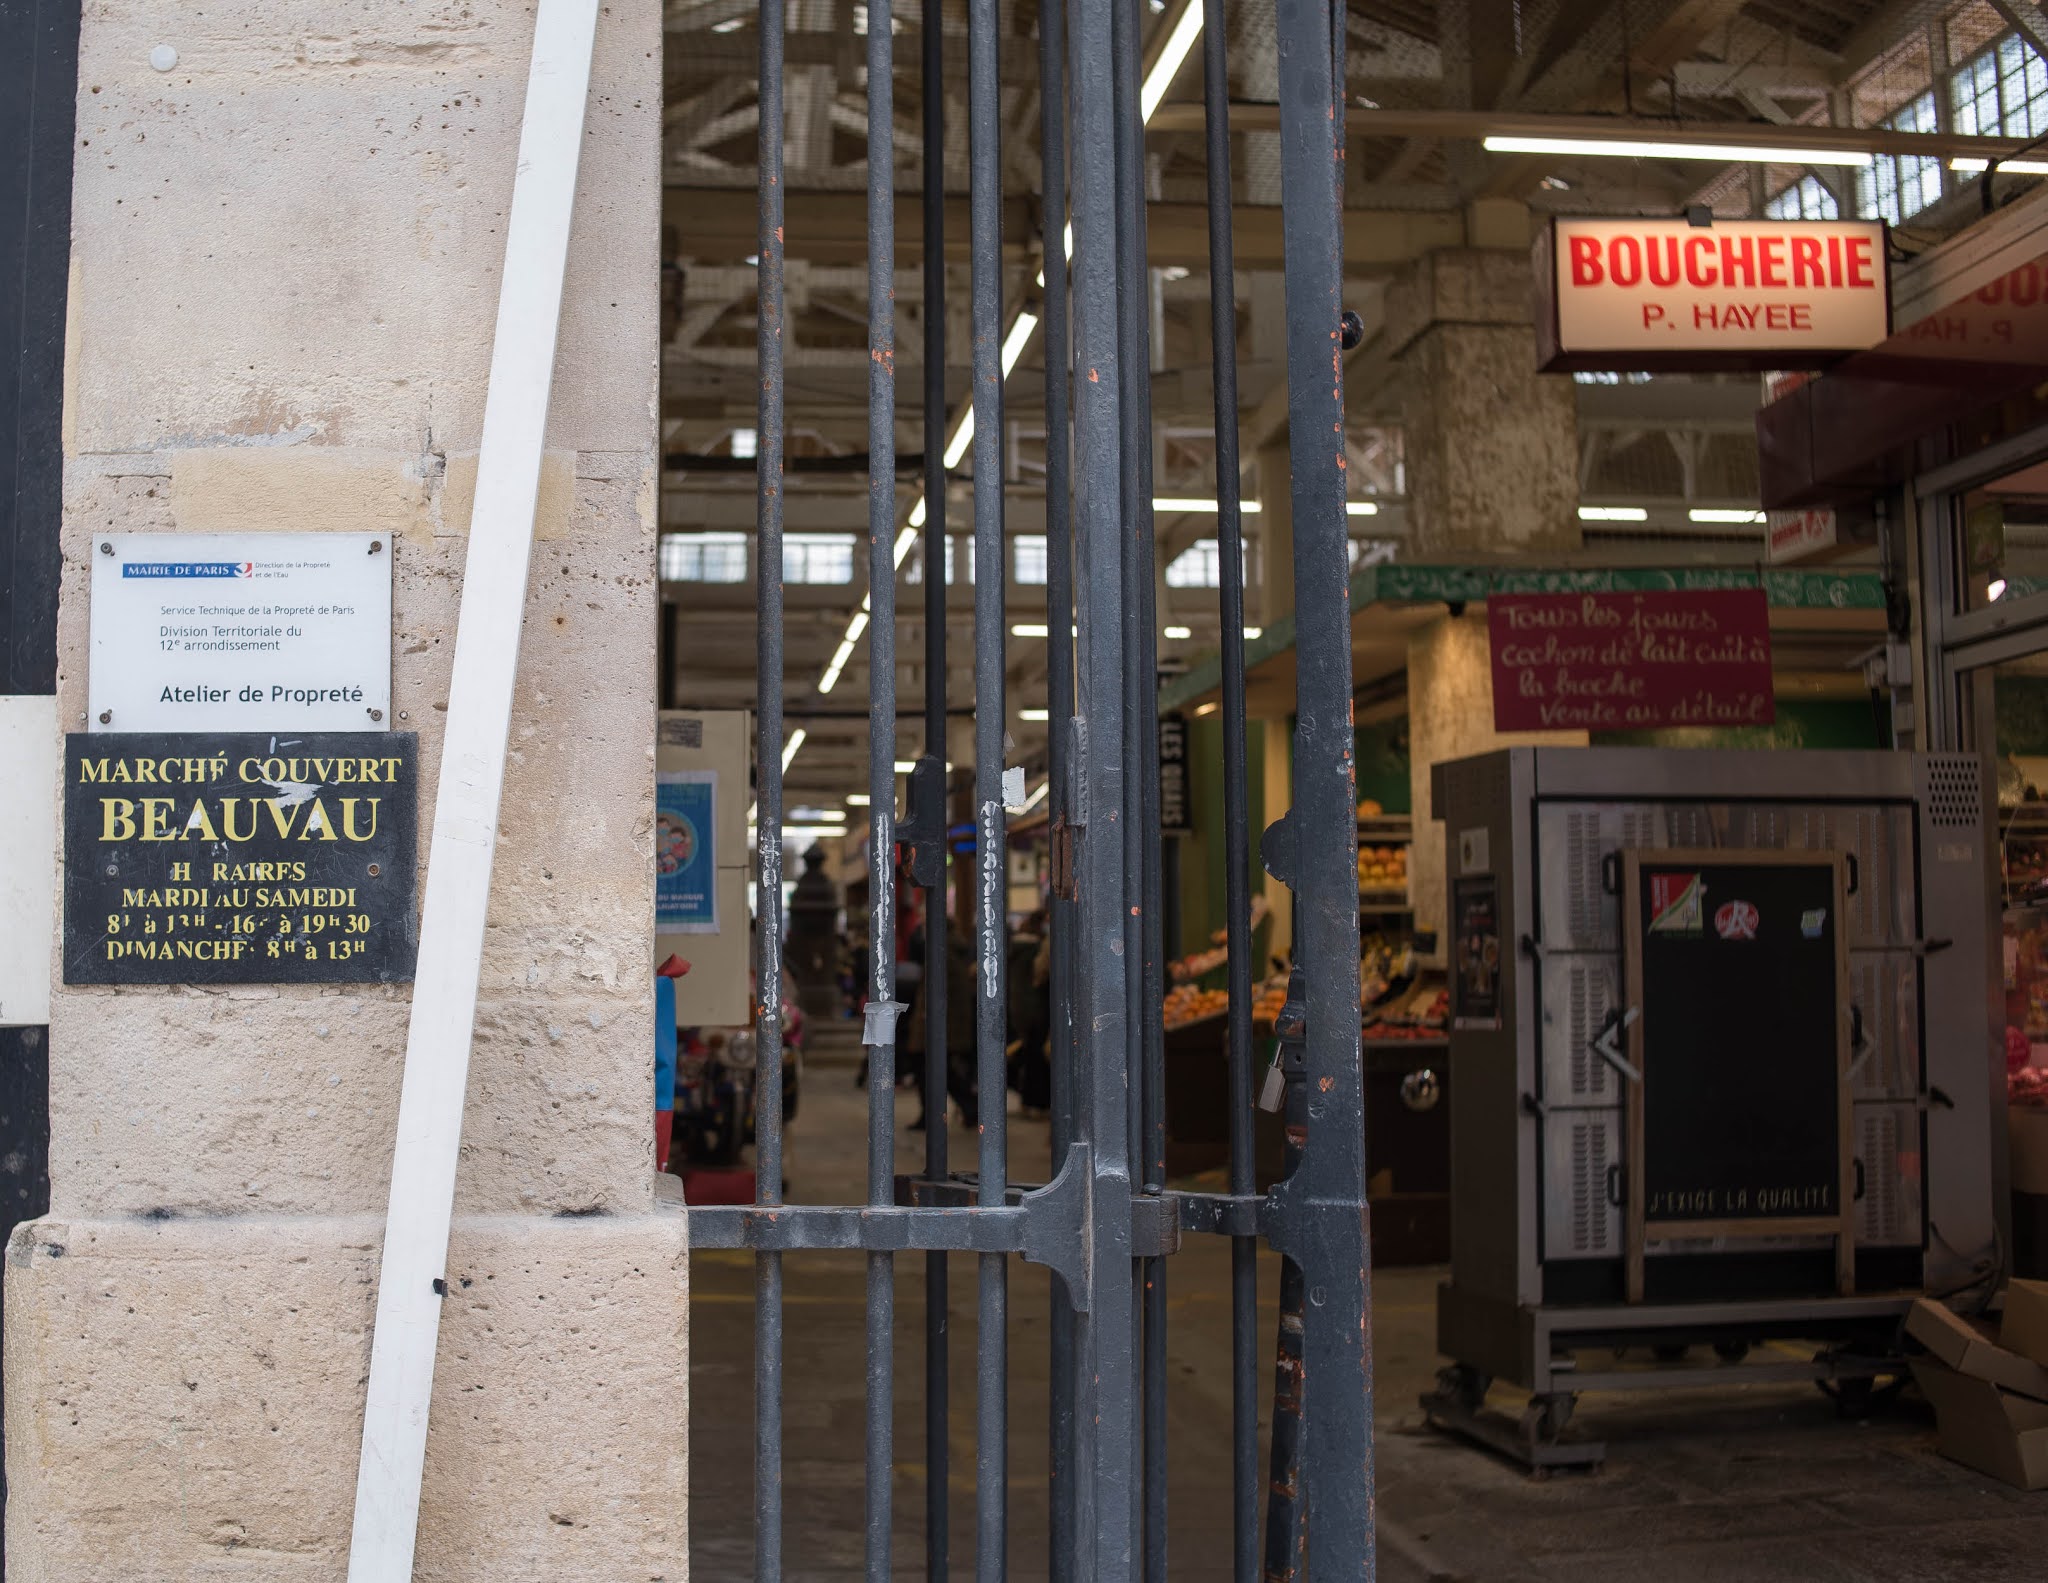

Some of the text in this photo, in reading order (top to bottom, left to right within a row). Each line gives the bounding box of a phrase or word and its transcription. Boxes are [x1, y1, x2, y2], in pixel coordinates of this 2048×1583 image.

[1568, 235, 1875, 288] BOUCHERIE
[1642, 304, 1812, 330] P. HAYEE
[128, 565, 229, 576] MAIRIE DE PARIS
[303, 561, 331, 570] Propreté
[160, 604, 355, 617] Service Technique de la Propreté de Paris
[1499, 594, 1718, 642] Tous les jours
[160, 625, 302, 637] Division Territoriale du
[184, 639, 280, 650] arrondissement
[1640, 632, 1688, 662] lait
[1519, 668, 1545, 697] la
[160, 684, 364, 706] Atelier de Propreté
[79, 750, 402, 783] MARCHÉ COUVERT
[98, 797, 381, 842] BEAUVAU
[172, 861, 306, 881] HRAIRES
[121, 888, 357, 908] MARDI AU SAMEDI
[144, 913, 156, 934] à
[279, 913, 292, 934] à
[305, 940, 318, 960] à
[327, 940, 366, 960] 13H
[1726, 1188, 1748, 1210] LA
